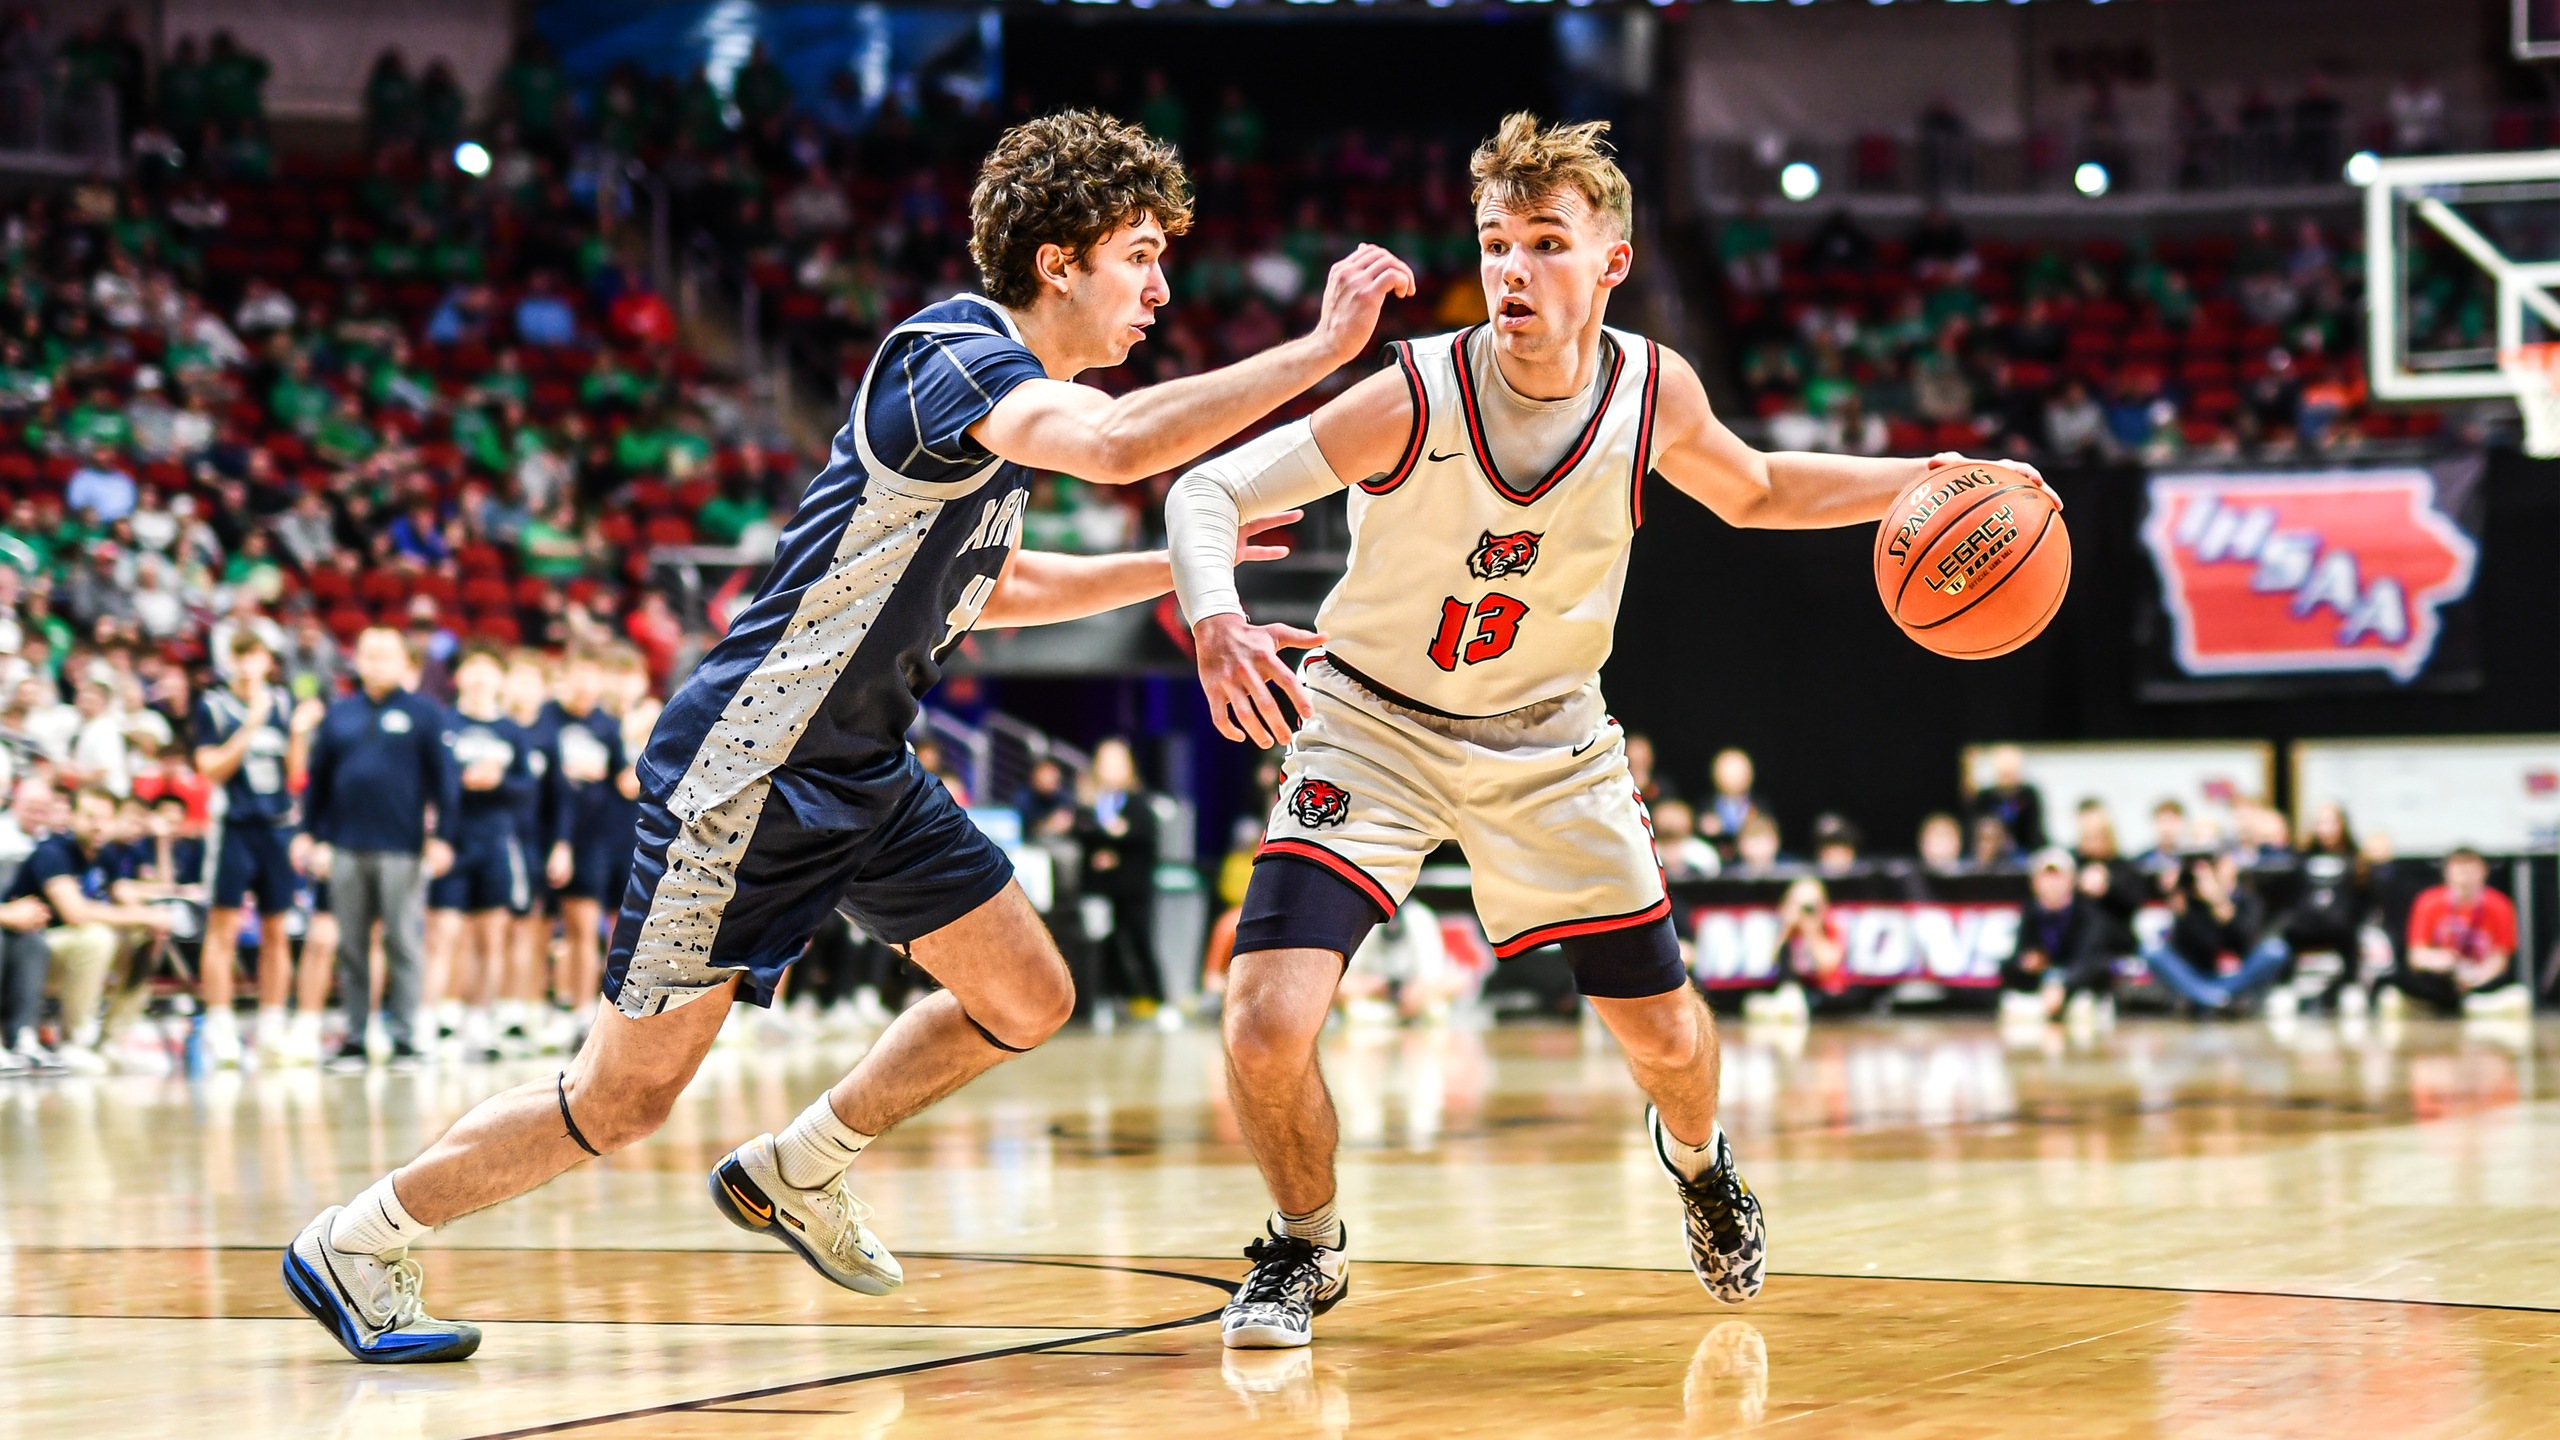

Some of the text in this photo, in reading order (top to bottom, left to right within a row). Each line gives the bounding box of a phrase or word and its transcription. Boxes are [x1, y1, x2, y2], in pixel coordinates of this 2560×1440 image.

[1888, 468, 1997, 567] SPALDING
[1923, 504, 2014, 593] LEGACY
[1948, 526, 2018, 592] TF 1000
[1968, 569, 1990, 590] OFFICIAL
[1988, 558, 2002, 571] GAME
[2174, 489, 2409, 648] IHSAA
[1427, 592, 1531, 672] 13
